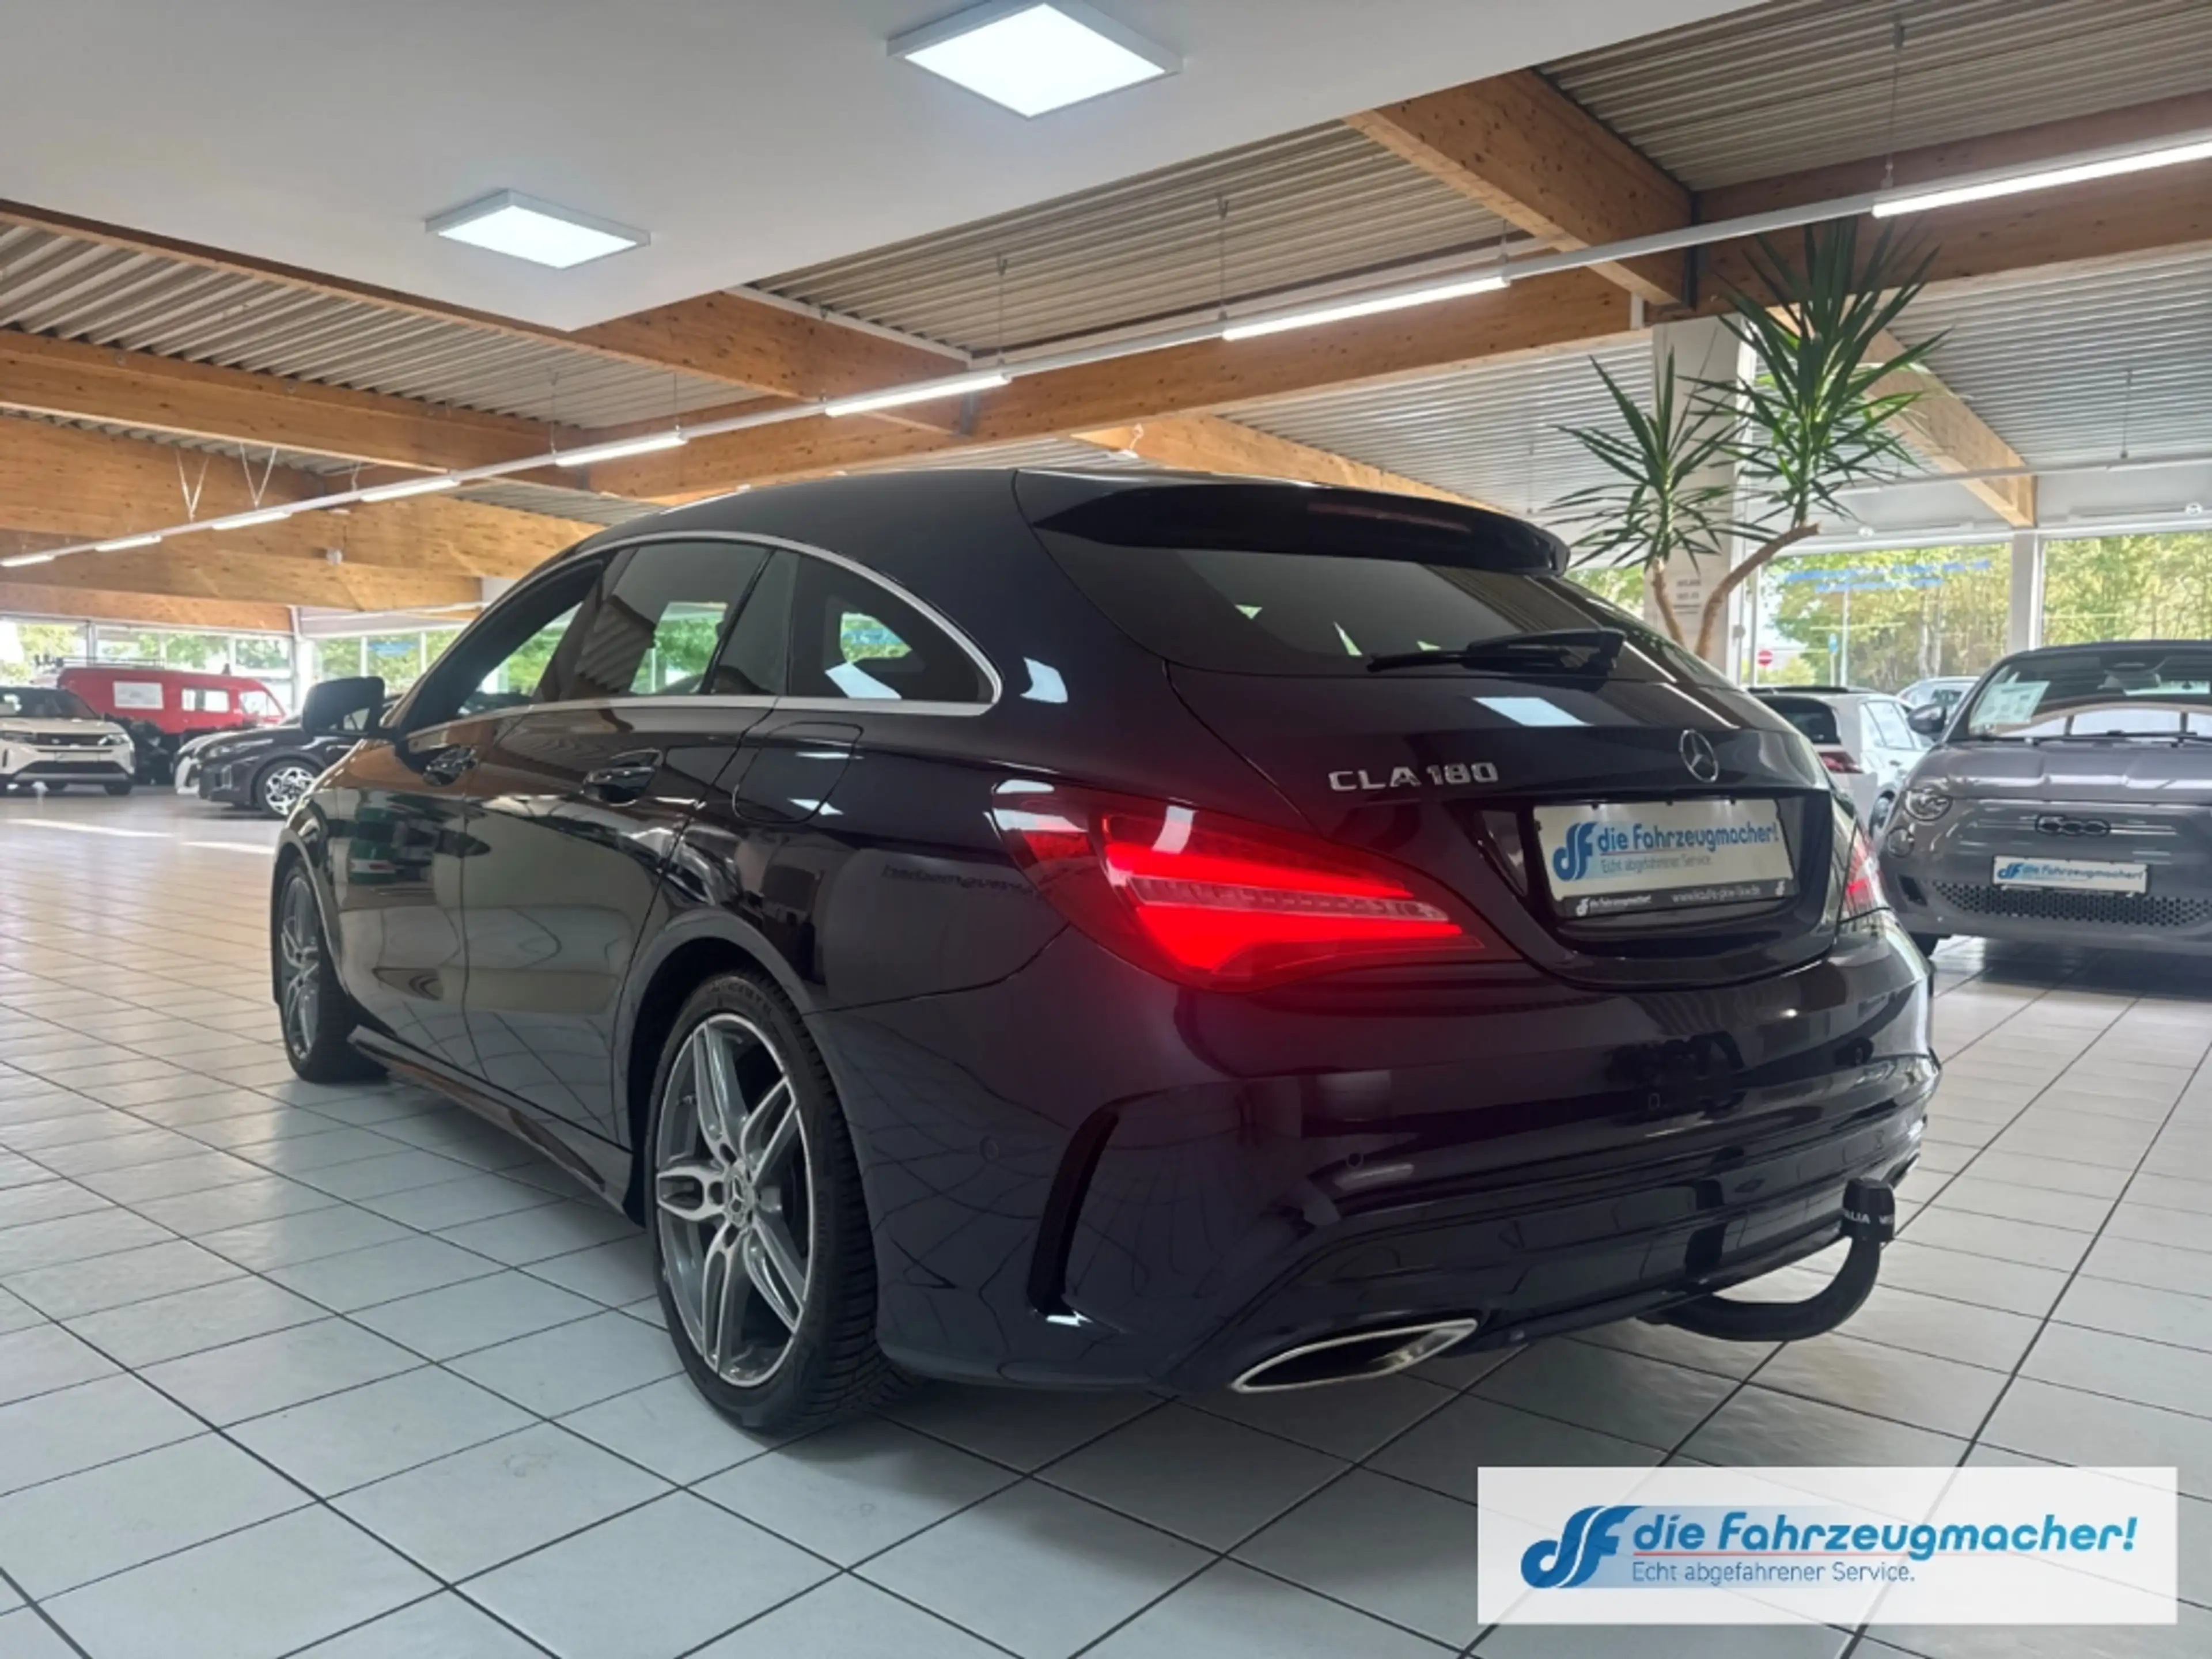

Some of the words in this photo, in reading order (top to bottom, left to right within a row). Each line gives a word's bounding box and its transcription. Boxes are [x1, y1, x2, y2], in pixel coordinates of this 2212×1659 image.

[1328, 767, 1422, 791] CLA
[1426, 762, 1498, 786] 180
[1597, 827, 1628, 853] die
[1633, 820, 1781, 853] Fahrzeugmacher!
